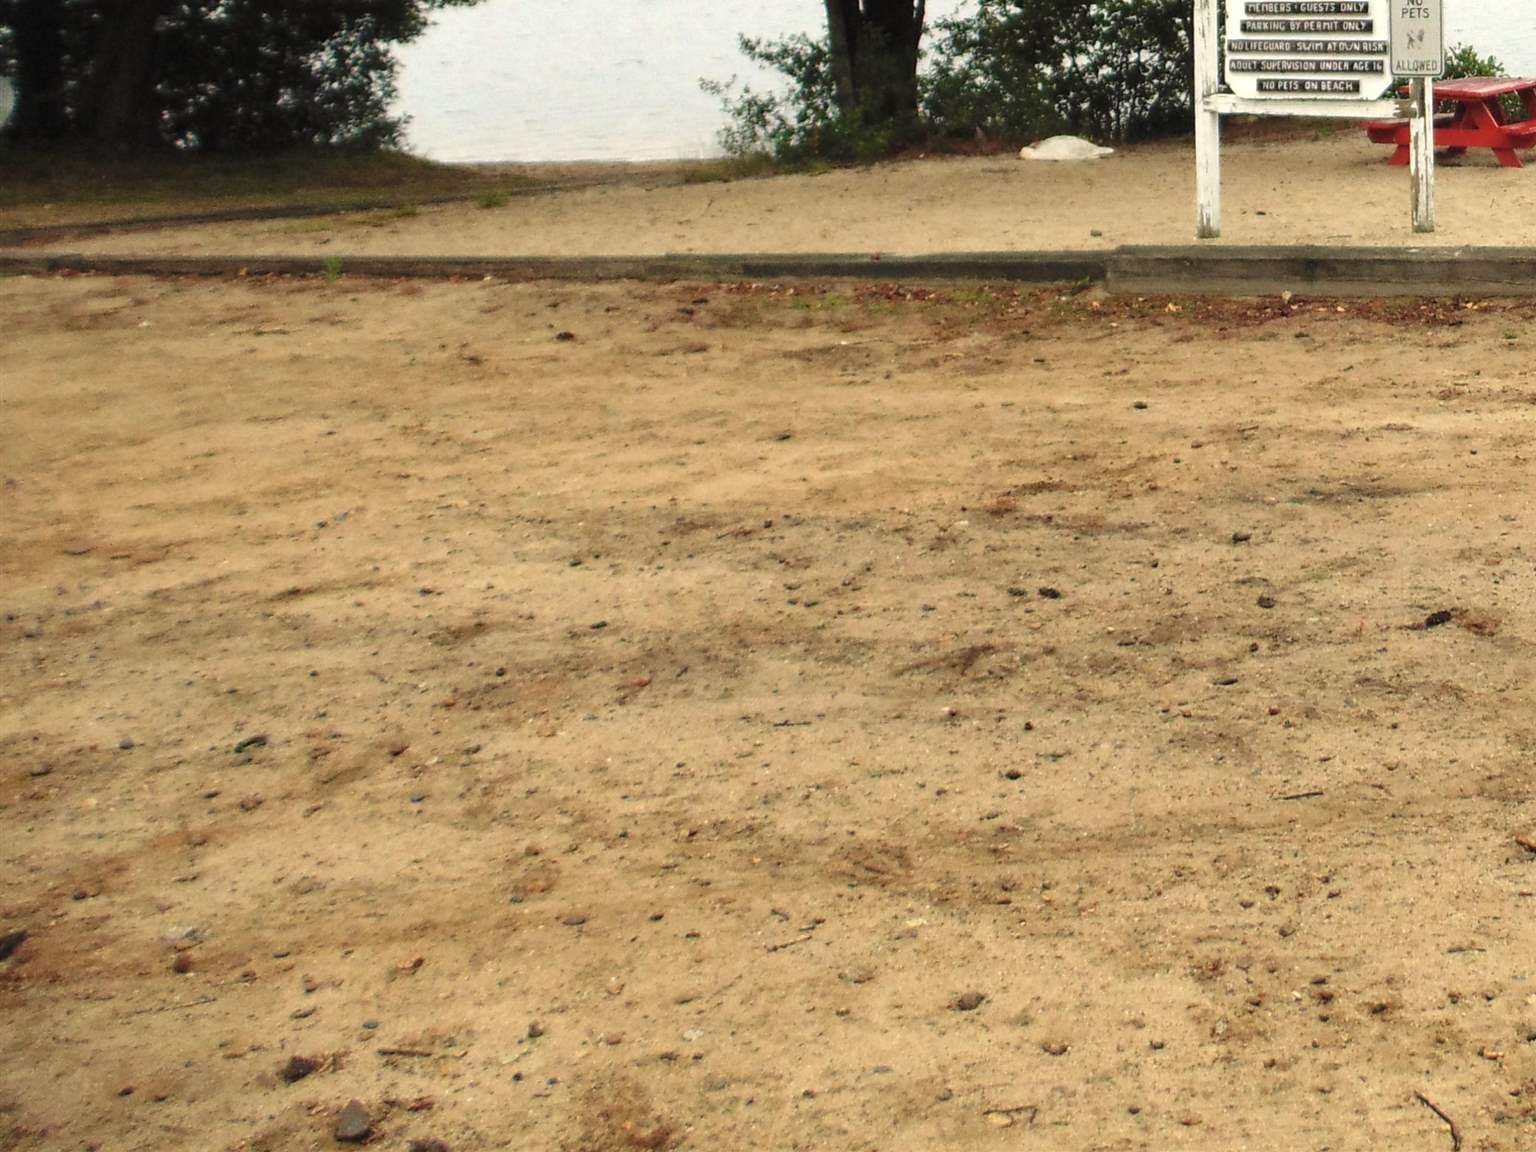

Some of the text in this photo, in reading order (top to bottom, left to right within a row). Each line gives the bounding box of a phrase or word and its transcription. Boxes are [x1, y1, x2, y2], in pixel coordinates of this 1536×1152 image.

[1248, 3, 1291, 13] MEMBERS
[1300, 3, 1335, 12] GUESTS
[1341, 2, 1365, 12] ONLY
[1401, 8, 1430, 19] PETS
[1246, 21, 1366, 31] PARKING BY PERMIT ONLY
[1296, 42, 1324, 52] SWIM
[1327, 42, 1337, 51] AT
[1230, 61, 1257, 70] ADULT
[1260, 61, 1316, 71] SUPERVISION
[1353, 61, 1370, 71] AGE
[1396, 59, 1438, 71] ALLOWED
[1262, 81, 1353, 91] NO PETS ON BEACH
